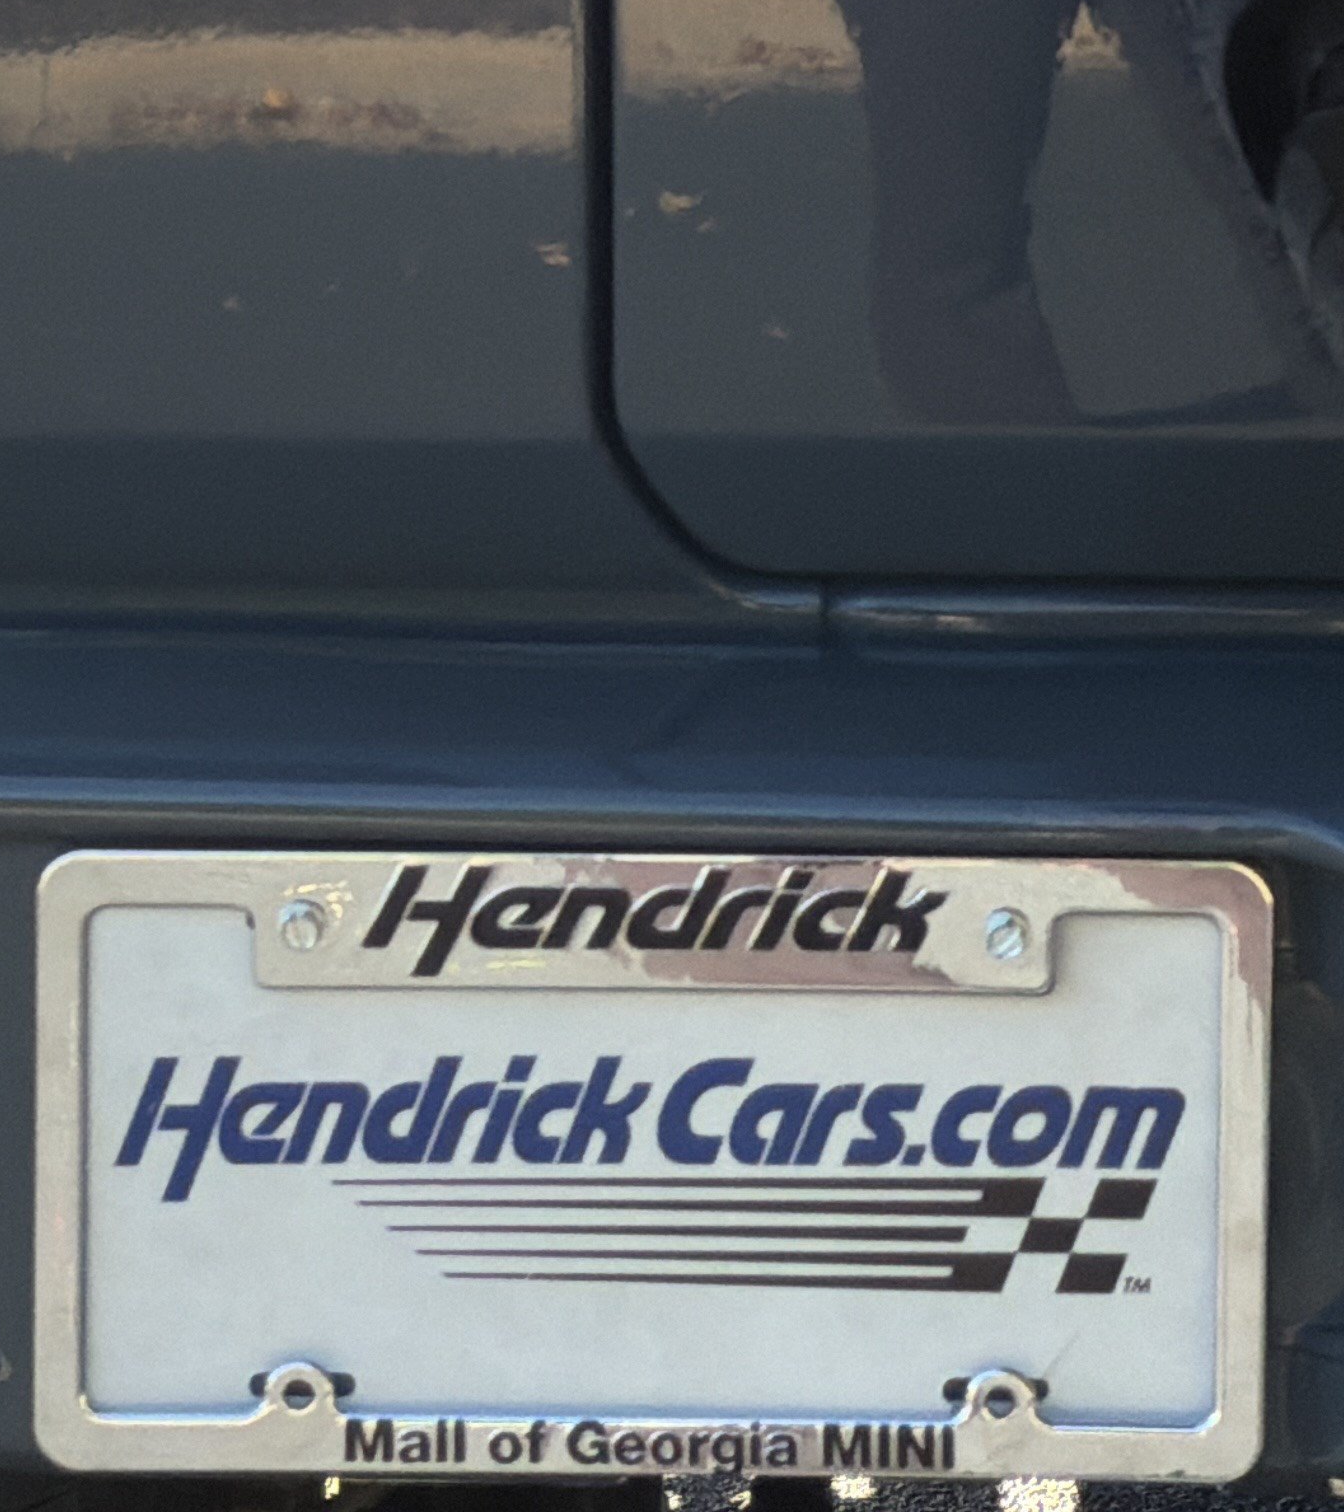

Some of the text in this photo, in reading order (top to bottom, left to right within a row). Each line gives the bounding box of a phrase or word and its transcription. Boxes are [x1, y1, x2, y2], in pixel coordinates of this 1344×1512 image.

[362, 865, 948, 978] Hendrick
[344, 1420, 955, 1478] Mall of Georgia MINI
